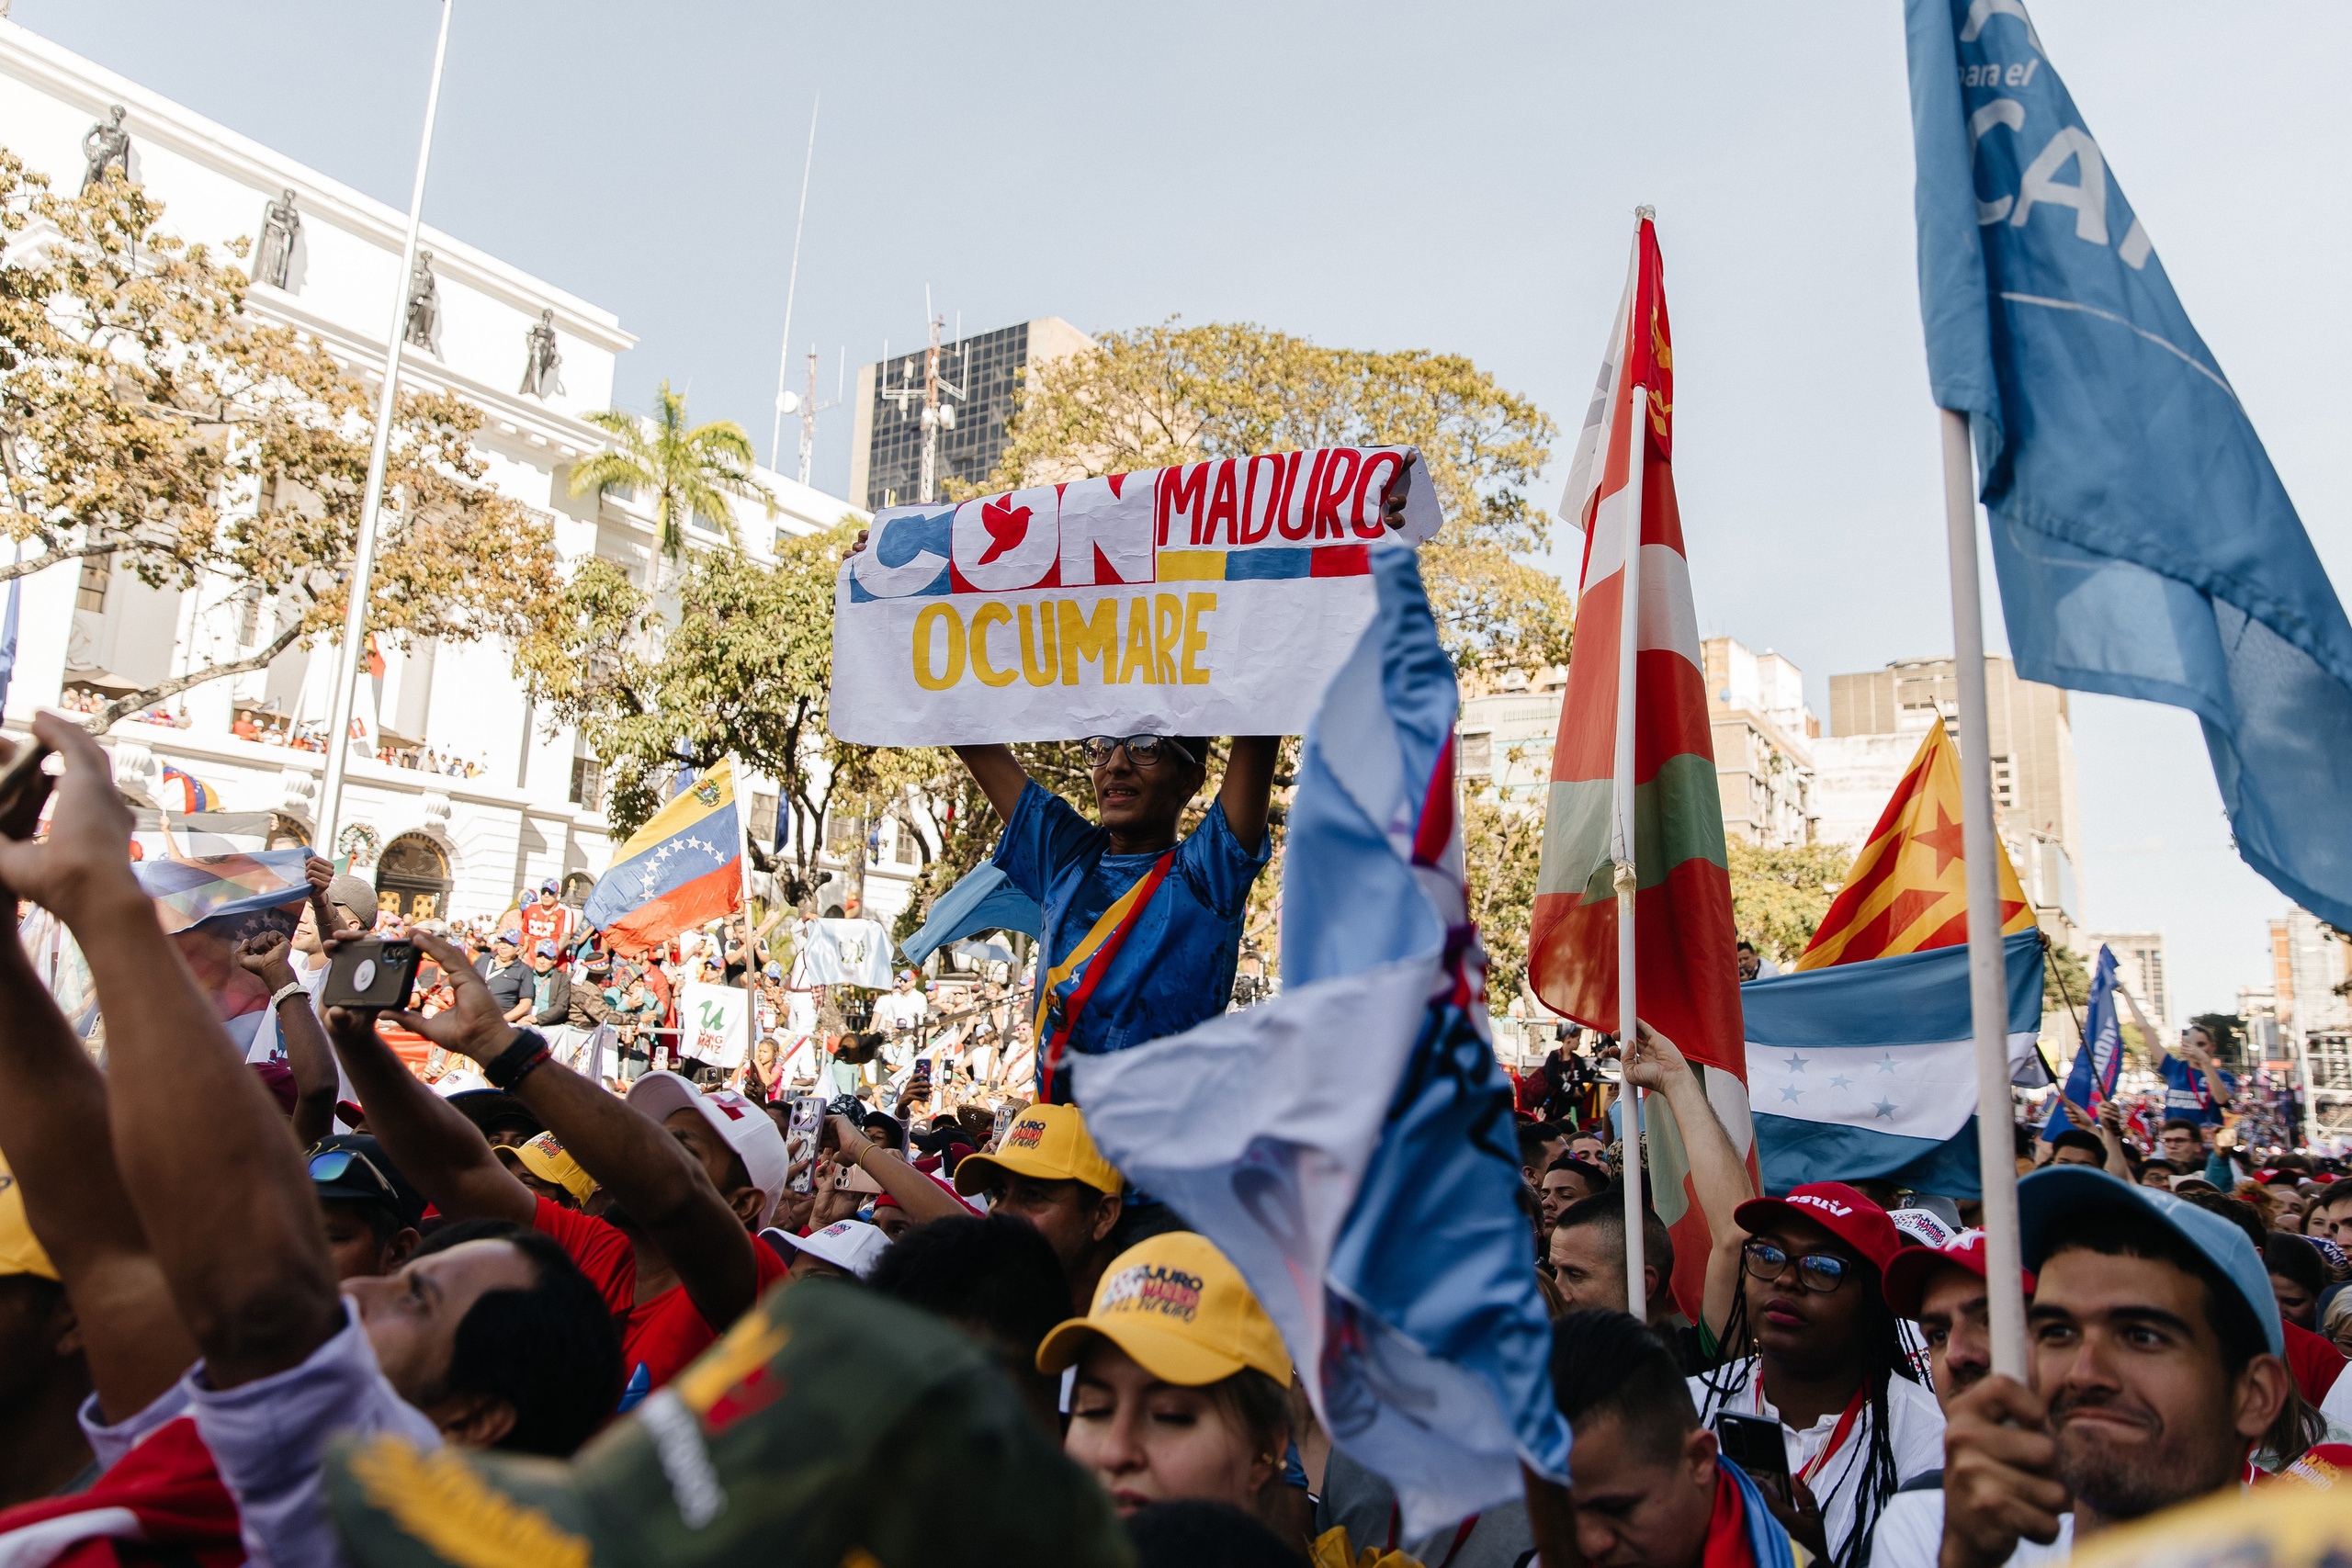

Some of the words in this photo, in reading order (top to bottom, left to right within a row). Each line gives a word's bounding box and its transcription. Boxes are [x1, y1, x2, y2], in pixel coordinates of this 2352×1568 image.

[2005, 58, 2039, 86] el
[851, 479, 1157, 604] CON
[1159, 447, 1402, 547] MADURO
[911, 592, 1217, 692] OCUMARE
[1015, 1120, 1046, 1132] JURO
